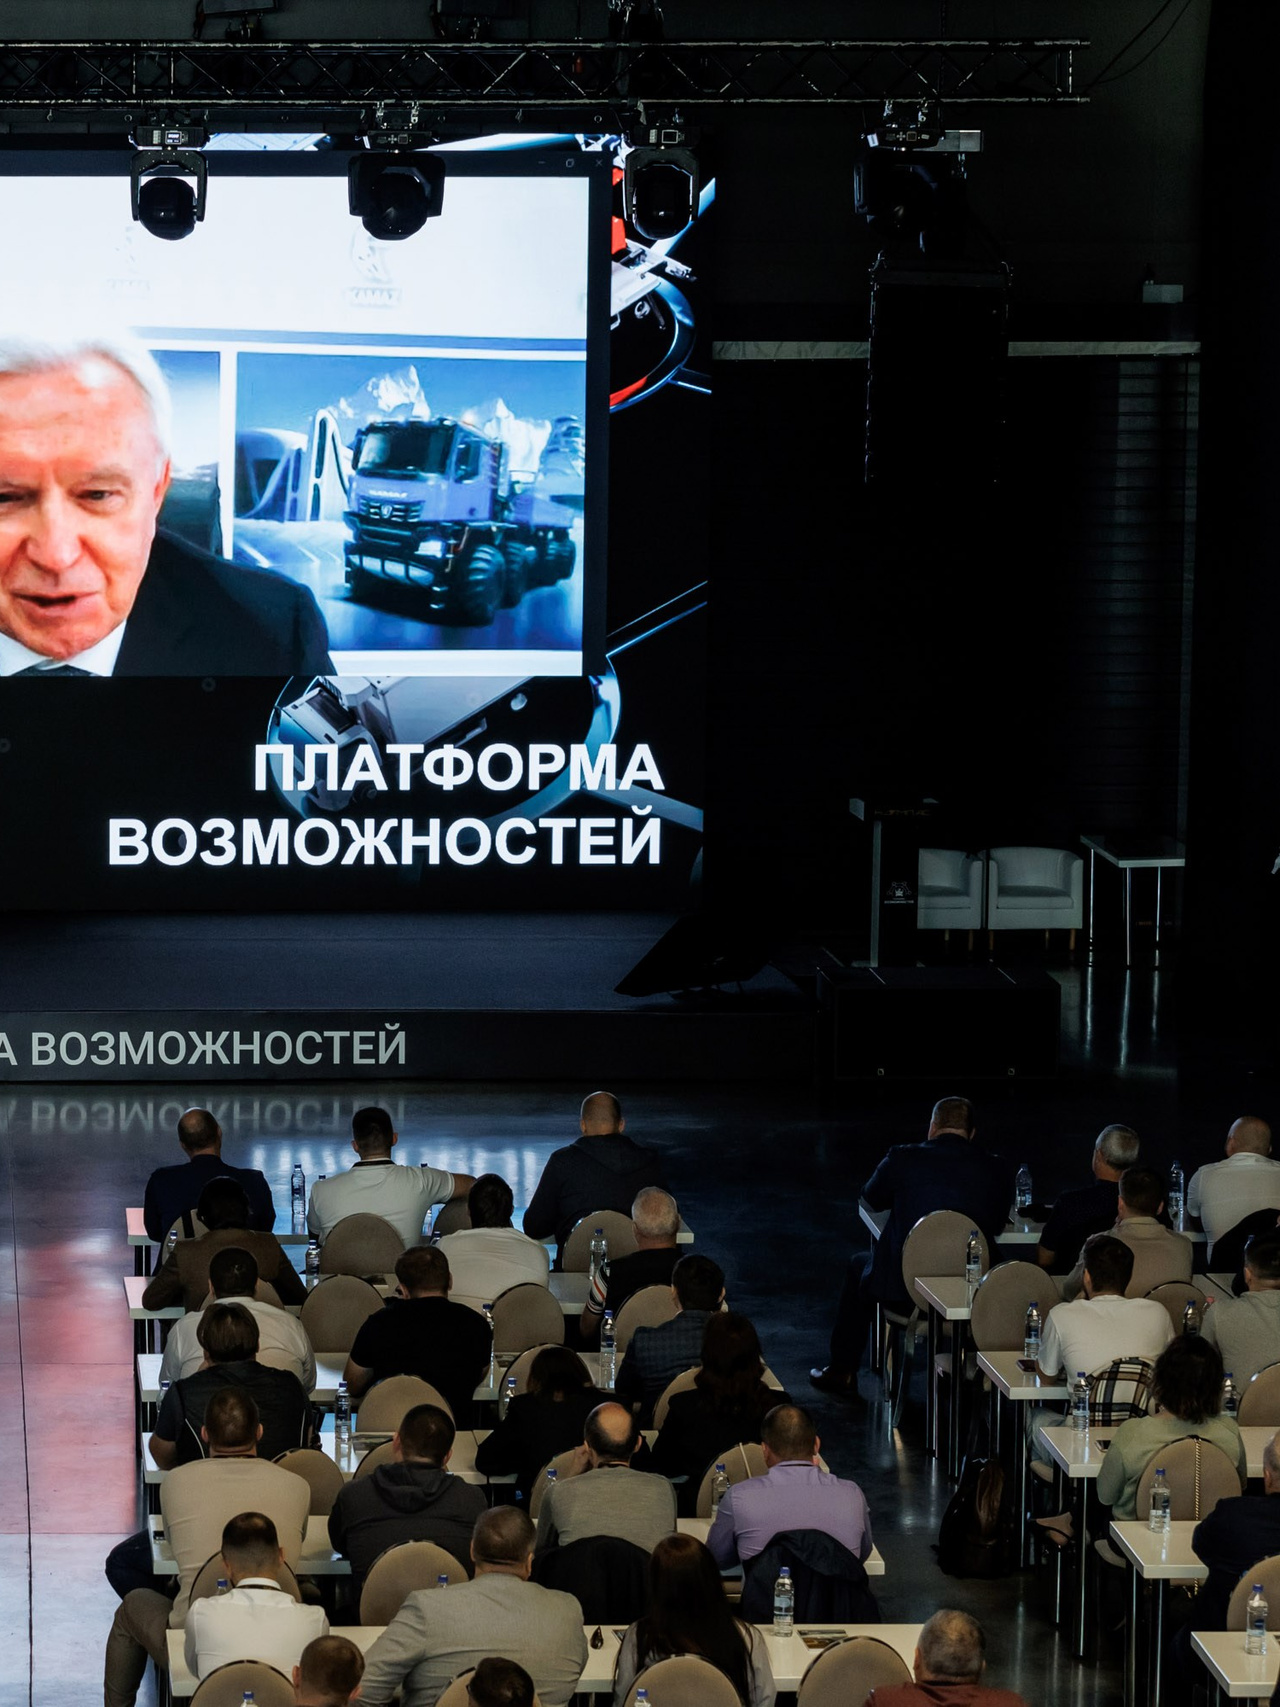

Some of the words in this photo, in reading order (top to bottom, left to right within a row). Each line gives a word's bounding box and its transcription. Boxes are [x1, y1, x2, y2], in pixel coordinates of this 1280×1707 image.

[254, 743, 665, 791] ПЛАТФОРМА
[108, 804, 662, 867] ВОЗМОЖНОСТЕЙ
[31, 1022, 406, 1066] ВОЗМОЖНОСТЕЙ
